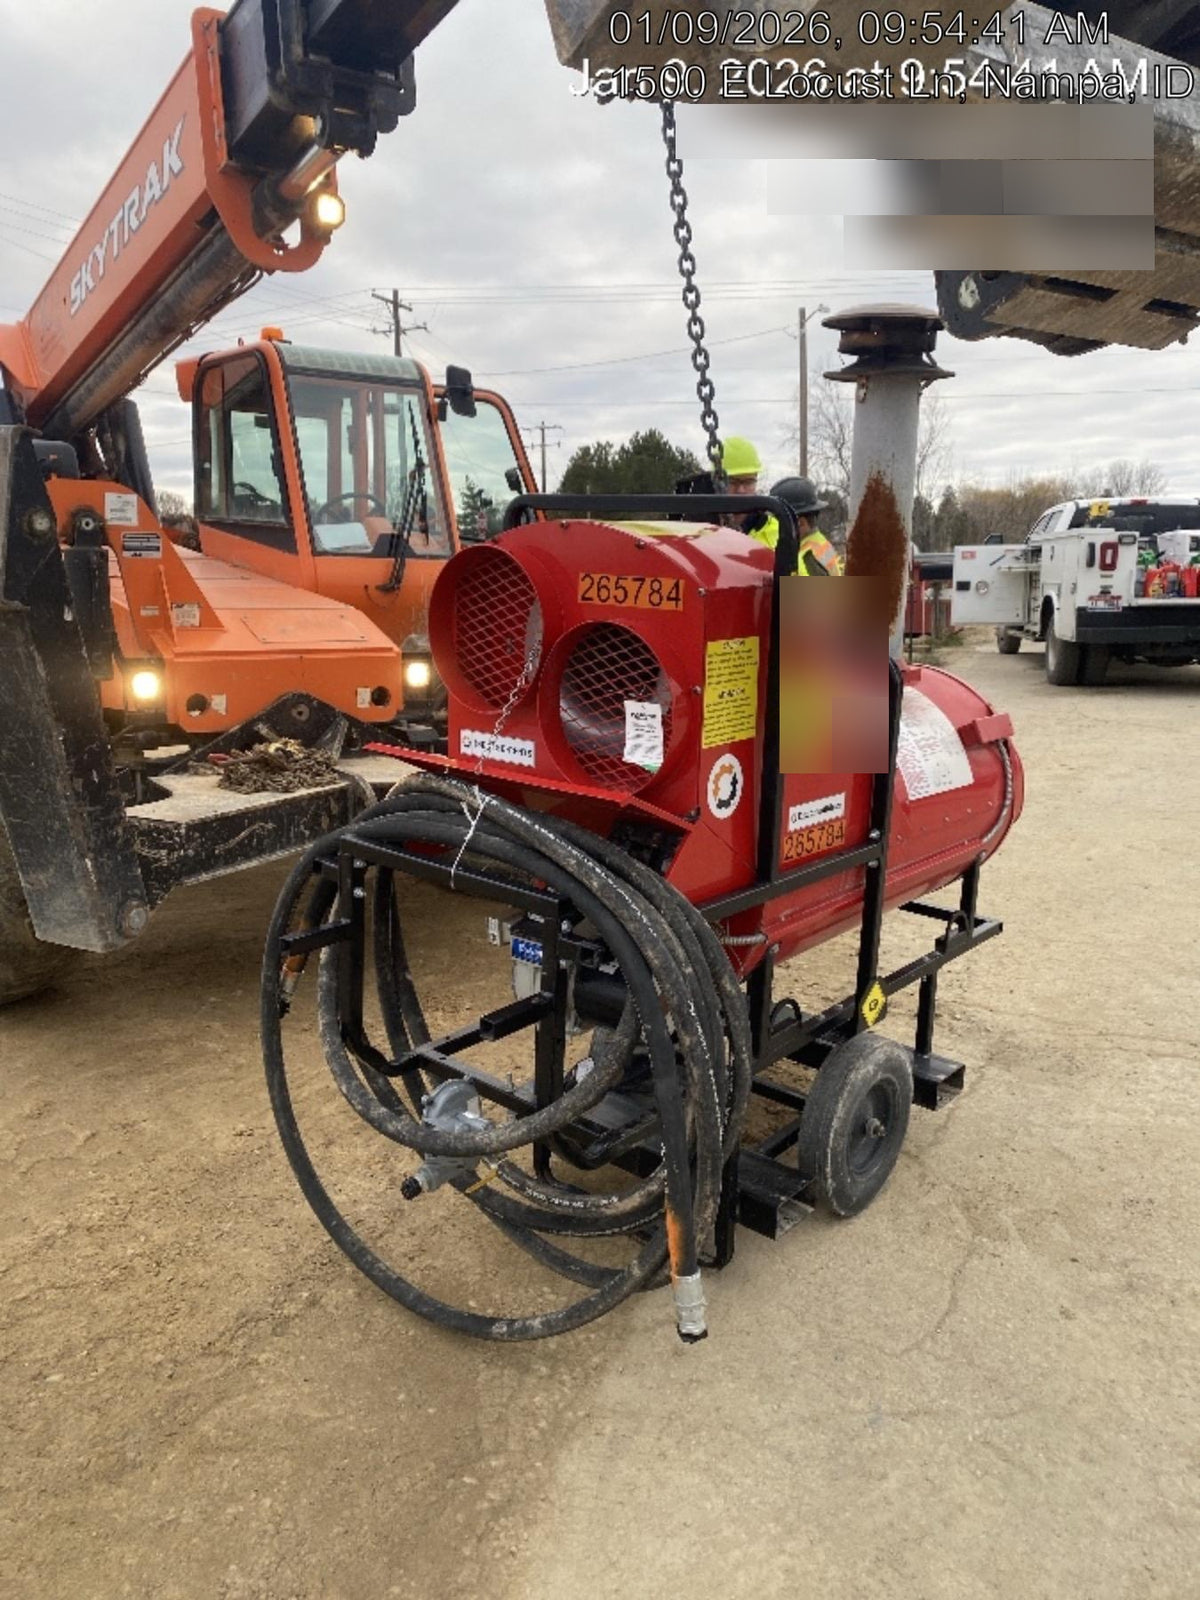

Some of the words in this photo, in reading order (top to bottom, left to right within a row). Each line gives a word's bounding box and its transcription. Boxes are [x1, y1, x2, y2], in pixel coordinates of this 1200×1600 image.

[69, 114, 187, 319] SKYTRAK
[580, 573, 682, 609] 265784
[783, 821, 845, 861] 265784
